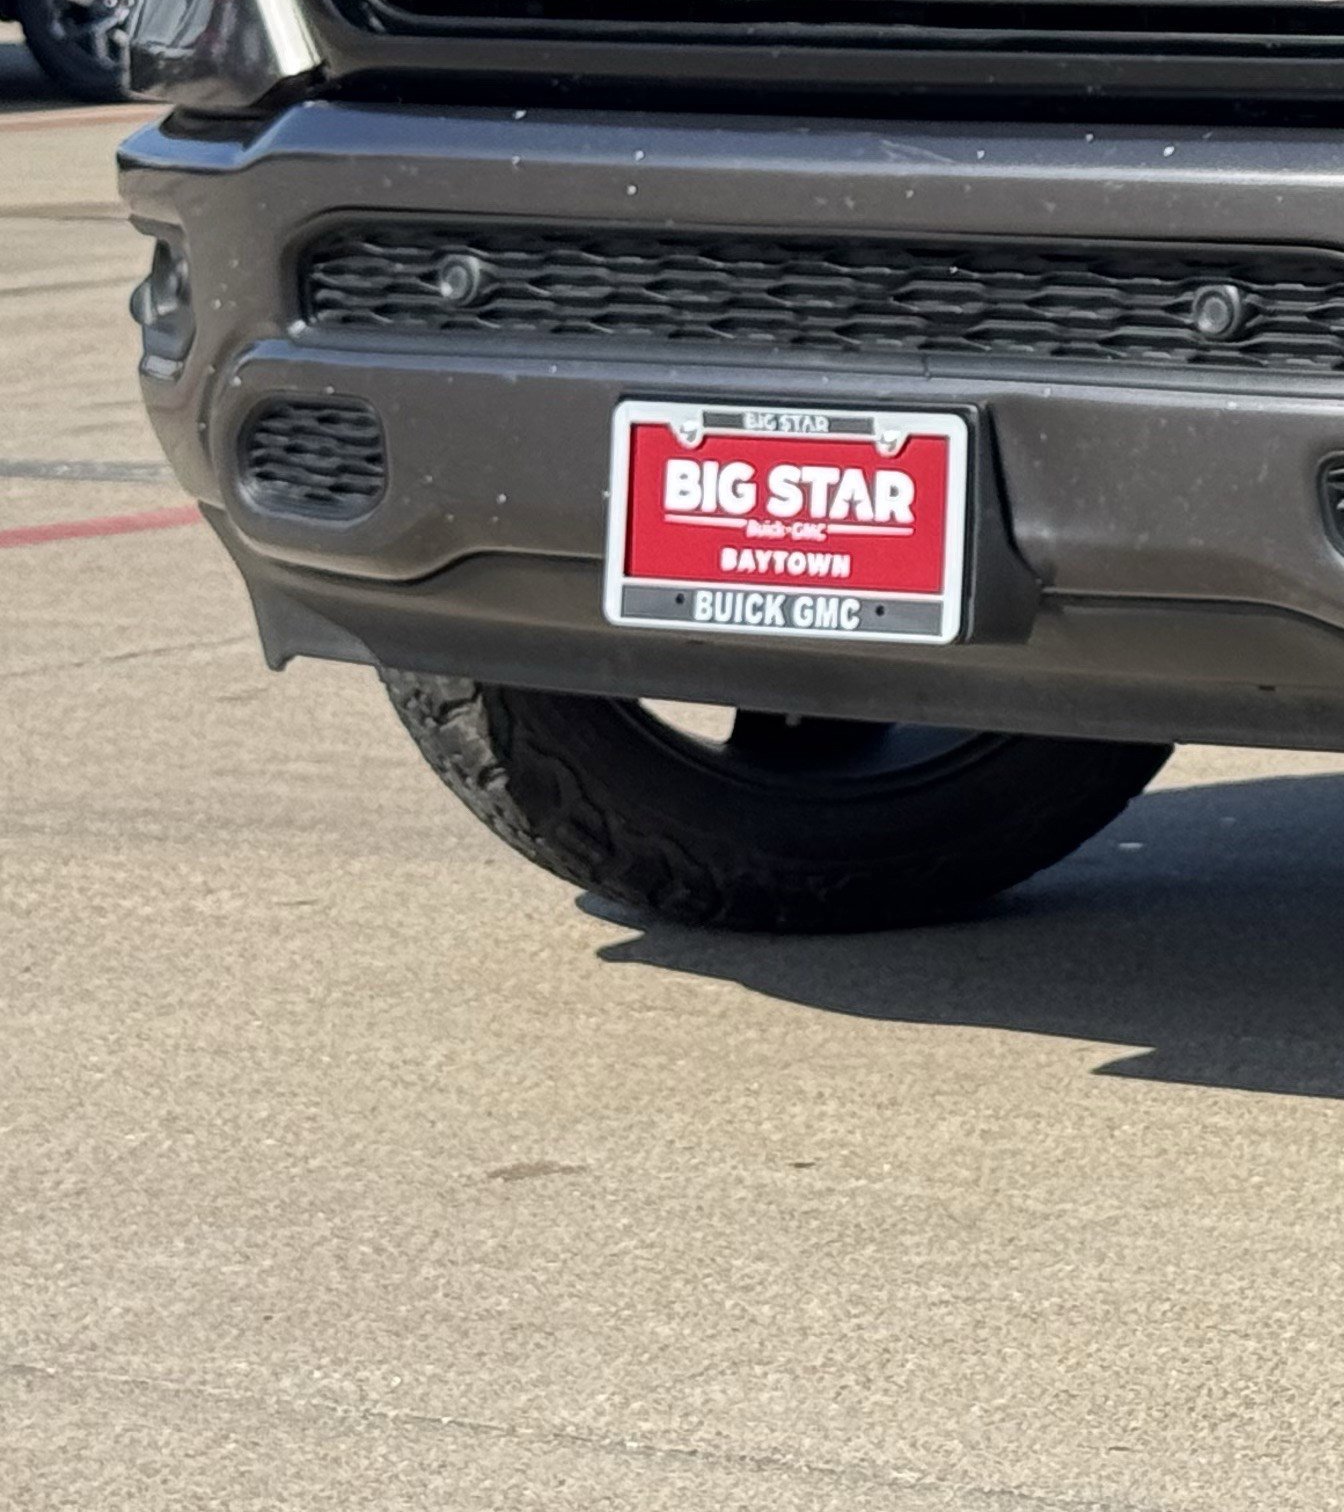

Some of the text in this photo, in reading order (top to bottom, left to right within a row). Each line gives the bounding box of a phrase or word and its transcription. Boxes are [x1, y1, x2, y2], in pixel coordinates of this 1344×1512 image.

[743, 412, 829, 433] BIG STAR
[664, 459, 915, 524] BIG STAR
[720, 547, 852, 579] BAYTOWN
[693, 590, 861, 631] BUICK GMC
